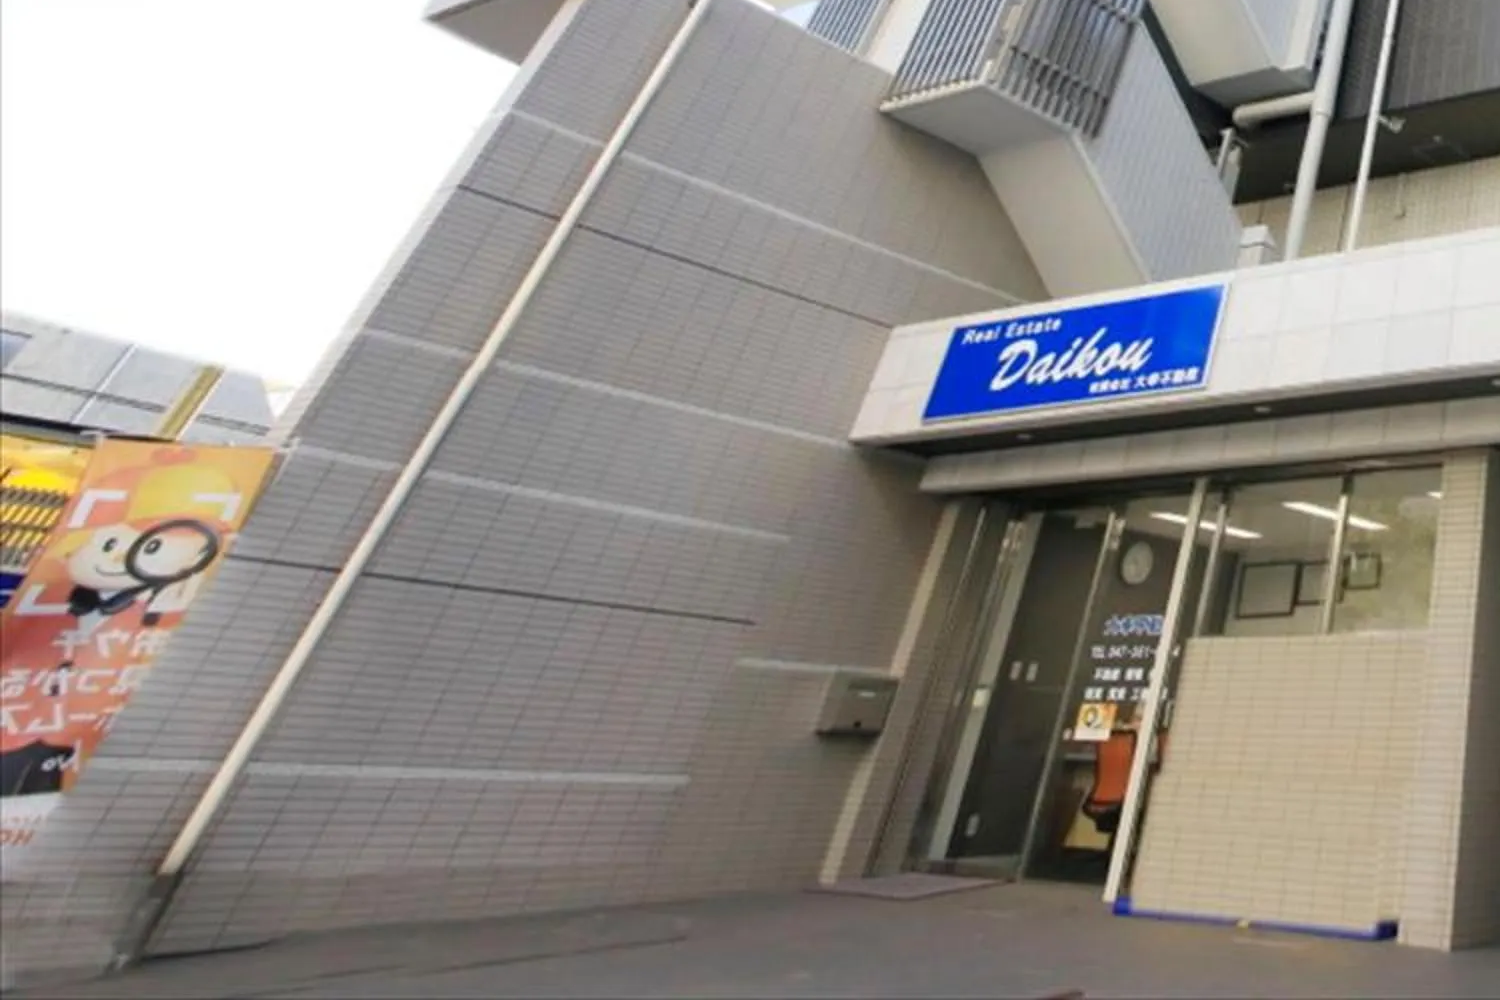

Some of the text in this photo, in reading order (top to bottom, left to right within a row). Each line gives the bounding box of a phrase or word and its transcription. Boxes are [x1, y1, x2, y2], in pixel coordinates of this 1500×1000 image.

[961, 318, 1062, 345] Real Estate
[989, 327, 1153, 392] Daikou
